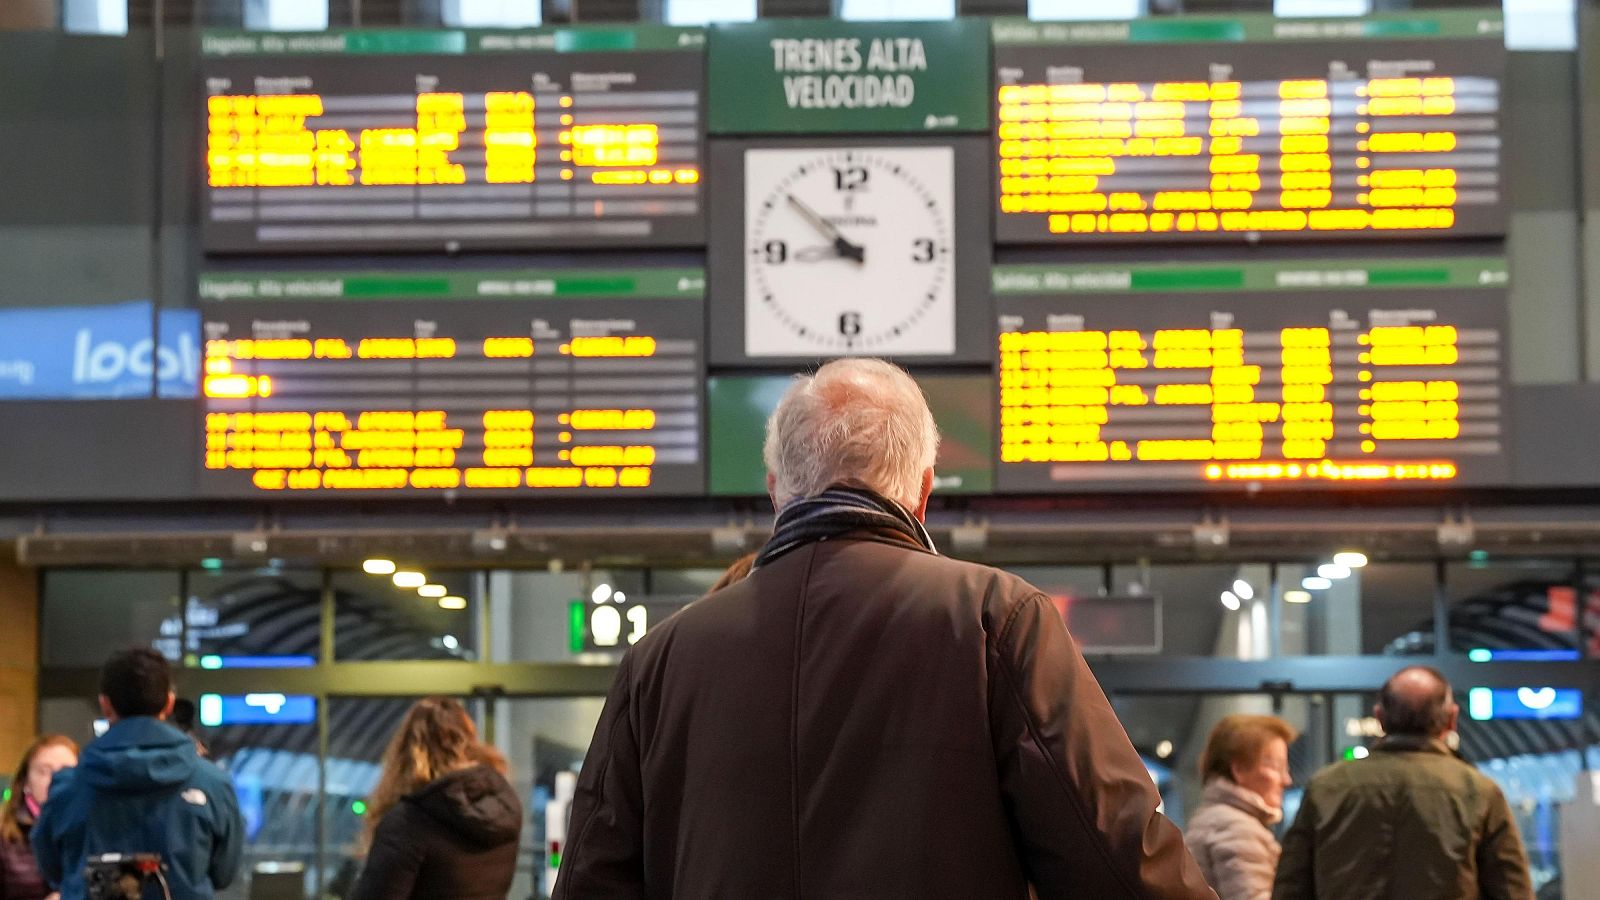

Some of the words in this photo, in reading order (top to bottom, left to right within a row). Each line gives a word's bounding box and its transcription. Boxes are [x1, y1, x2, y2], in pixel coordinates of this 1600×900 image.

[771, 38, 862, 71] TRENES
[867, 38, 927, 71] ALTA
[784, 75, 914, 108] VELOCIDAD
[835, 167, 869, 190] 12
[766, 239, 787, 264] 9
[912, 238, 934, 263] 3
[839, 312, 861, 335] 6
[591, 604, 647, 646] 01
